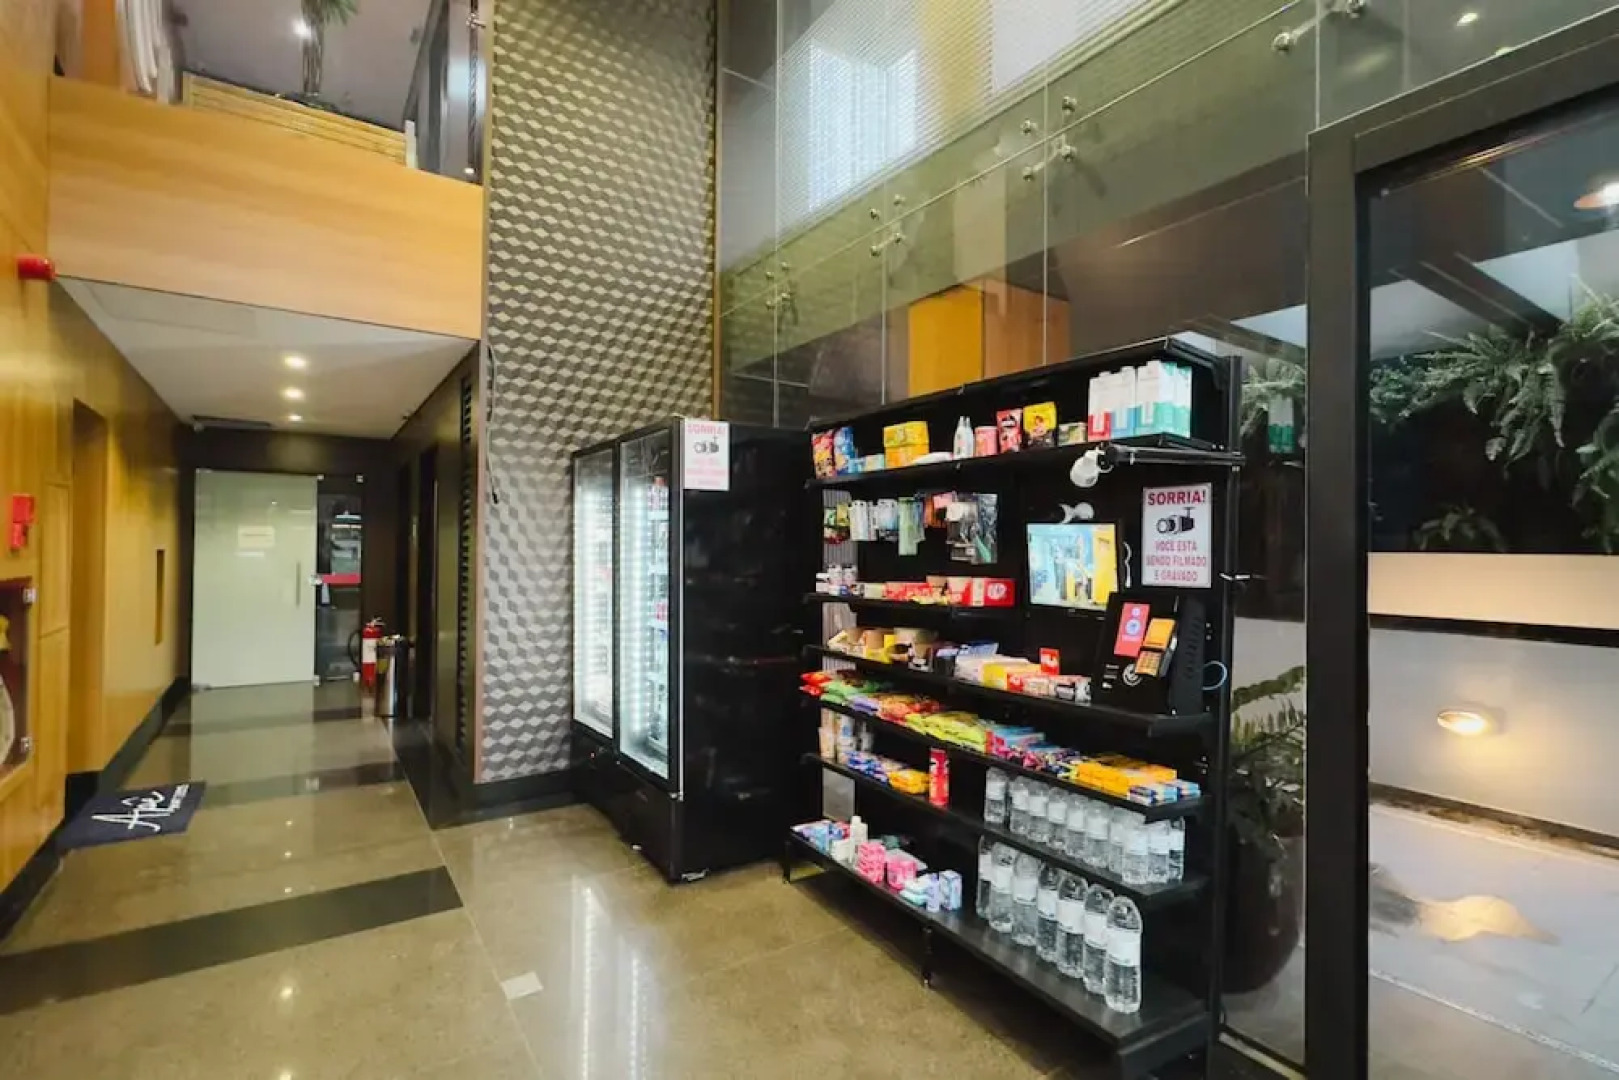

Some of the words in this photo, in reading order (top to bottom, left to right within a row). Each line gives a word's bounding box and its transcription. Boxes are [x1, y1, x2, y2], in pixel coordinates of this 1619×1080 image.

[1148, 490, 1206, 506] SORRIA!
[1173, 555, 1206, 567] FILMADO
[1161, 570, 1198, 581] GRAVADO
